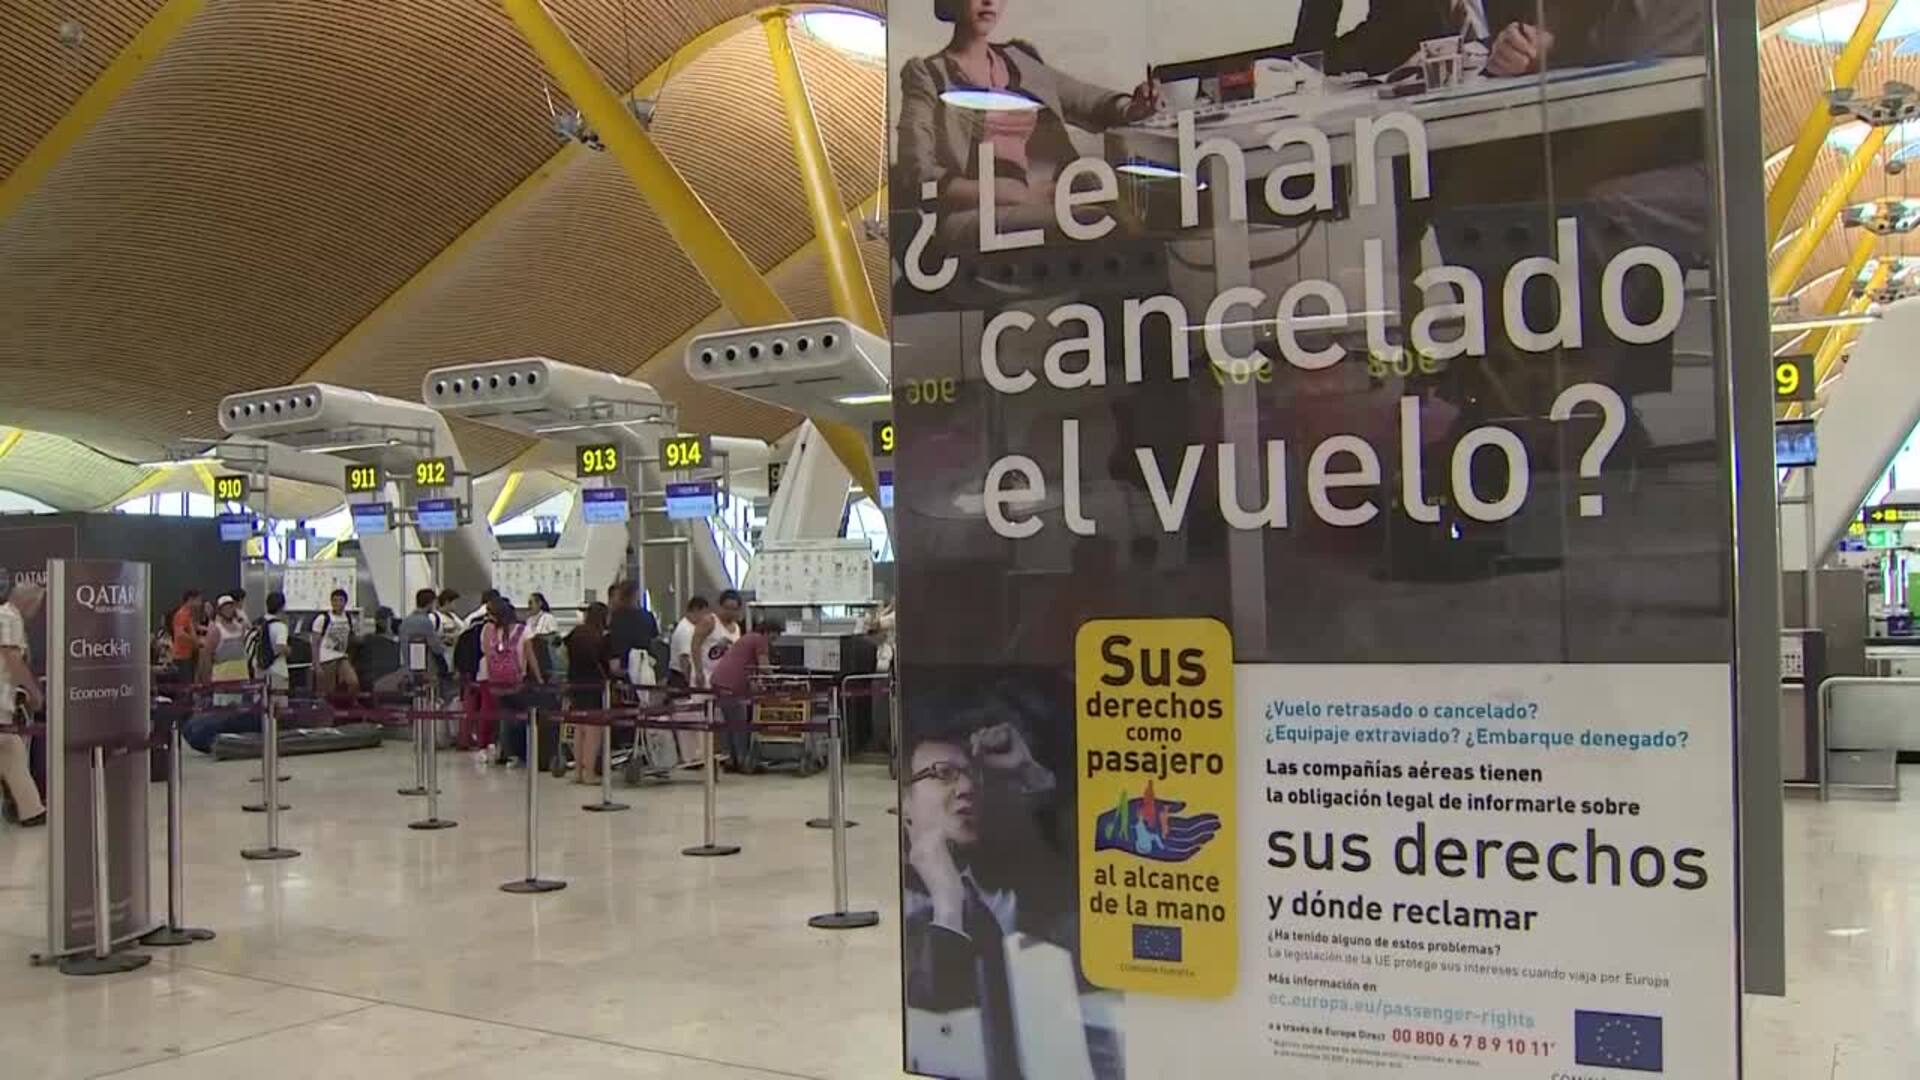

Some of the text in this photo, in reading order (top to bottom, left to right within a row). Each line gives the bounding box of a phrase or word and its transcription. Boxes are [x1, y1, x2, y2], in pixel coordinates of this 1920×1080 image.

[903, 110, 1431, 292] ¿Le han
[980, 217, 1685, 394] cancelado
[583, 448, 616, 473] 913
[666, 441, 702, 466] 914
[983, 382, 1628, 539] el vuelo?
[351, 468, 376, 489] 911
[416, 462, 445, 484] 912
[218, 479, 241, 499] 910
[76, 584, 136, 609] QATAR
[70, 637, 131, 659] Check-in
[1100, 635, 1207, 687] Sus
[69, 685, 119, 701] Economy
[1086, 691, 1223, 719] derechos
[1265, 700, 1538, 721] ¿Vuelo retrasado o cancelado?
[1126, 724, 1182, 743] como
[1265, 725, 1689, 751] ¿Equipaje extraviado? ¿Embarque denegado?
[1087, 746, 1224, 781] pasajero
[1266, 758, 1542, 783] Las compañías aéreas tienen
[1266, 787, 1640, 817] la obligación legal de informarle sobre
[1267, 821, 1708, 890] sus derechos
[1094, 864, 1220, 893] al alcance
[1090, 892, 1226, 923] de la mano
[1267, 890, 1538, 931] y dónde reclamar
[1268, 929, 1501, 956] ¿Ha tenido alguno de estos problemas?
[1268, 948, 1282, 959] La
[1284, 948, 1342, 963] legislación
[1345, 952, 1358, 964] de
[1361, 953, 1372, 965] la
[1375, 955, 1390, 967] UE
[1441, 962, 1461, 973] sus
[1464, 963, 1519, 977] intereses
[1522, 968, 1566, 981] cuando
[1569, 970, 1597, 985] viaja
[1600, 973, 1620, 985] por
[1625, 972, 1670, 988] Europa
[1268, 973, 1377, 992] Más información en
[1268, 993, 1535, 1029] ec.europa.eu/passenger-rights
[1283, 1022, 1310, 1034] través
[1312, 1024, 1323, 1035] de
[1358, 1030, 1386, 1042] Direct
[1392, 1027, 1411, 1043] 00
[1415, 1030, 1445, 1047] 800
[1449, 1034, 1459, 1048] 6
[1463, 1035, 1473, 1049] 7
[1477, 1036, 1487, 1050] 8
[1491, 1037, 1501, 1051] 9
[1507, 1038, 1525, 1055] 10
